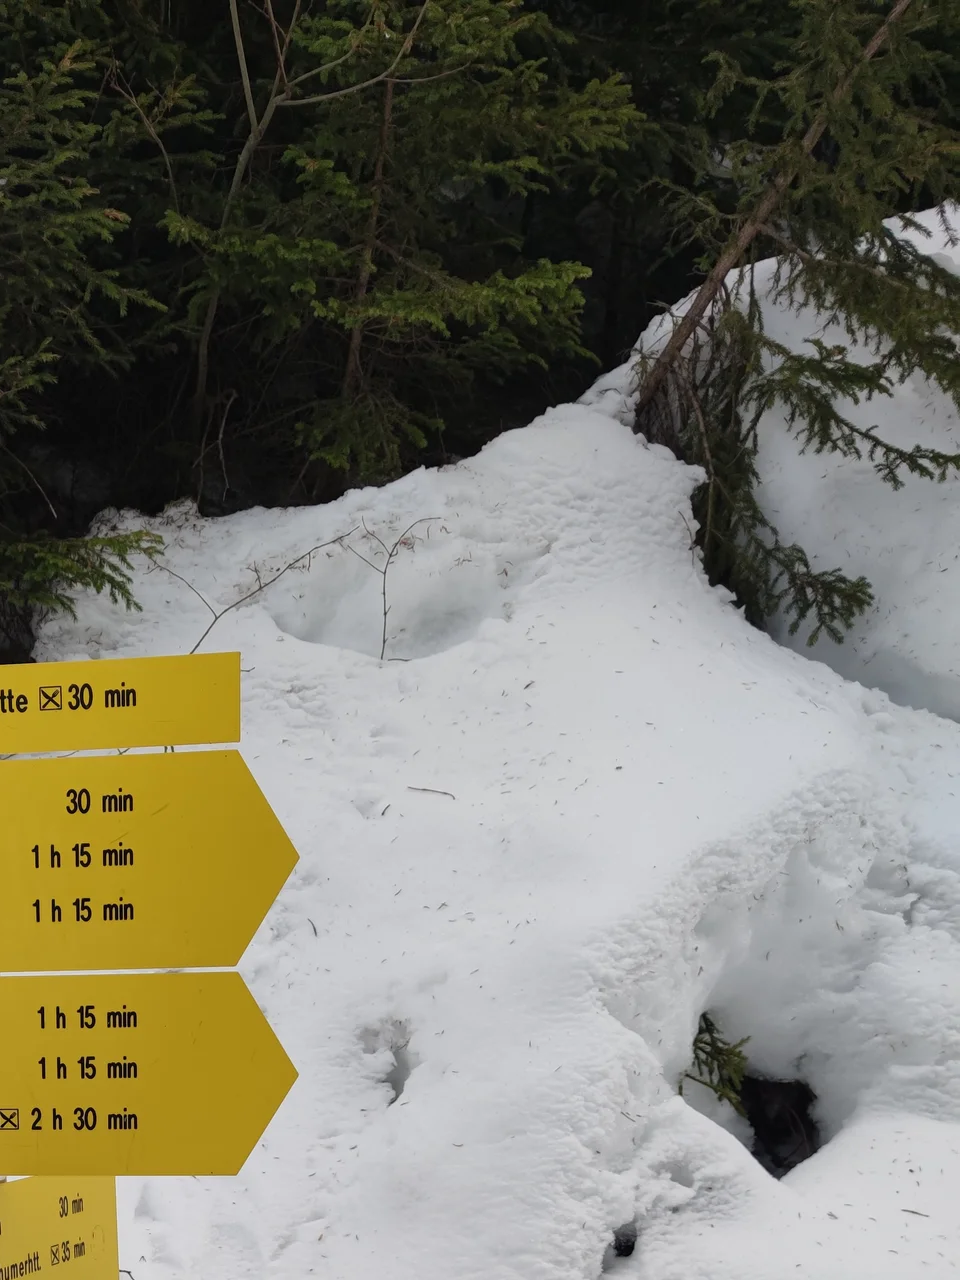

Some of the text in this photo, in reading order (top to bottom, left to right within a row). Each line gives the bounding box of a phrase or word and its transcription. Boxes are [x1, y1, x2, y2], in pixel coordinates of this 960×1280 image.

[68, 683, 93, 710] 30
[105, 682, 136, 708] min
[66, 789, 90, 814] 30
[102, 788, 133, 812] min
[32, 845, 39, 868] 1
[51, 845, 60, 868] h
[72, 843, 91, 867] 15
[103, 842, 133, 866] min
[33, 899, 40, 922] 1
[52, 899, 61, 922] h
[73, 898, 92, 922] 15
[103, 897, 133, 921] min
[38, 1007, 44, 1029] 1
[56, 1006, 66, 1028] h
[77, 1006, 95, 1028] 15
[107, 1005, 137, 1028] min
[39, 1057, 45, 1079] 1
[57, 1057, 66, 1079] h
[78, 1056, 96, 1079] 15
[108, 1056, 137, 1078] min
[31, 1108, 42, 1130] 2
[53, 1108, 62, 1130] h
[74, 1107, 96, 1130] 30
[108, 1108, 137, 1129] min
[59, 1196, 68, 1218] 30
[72, 1193, 83, 1214] min
[62, 1241, 70, 1262] 35
[74, 1237, 85, 1258] min
